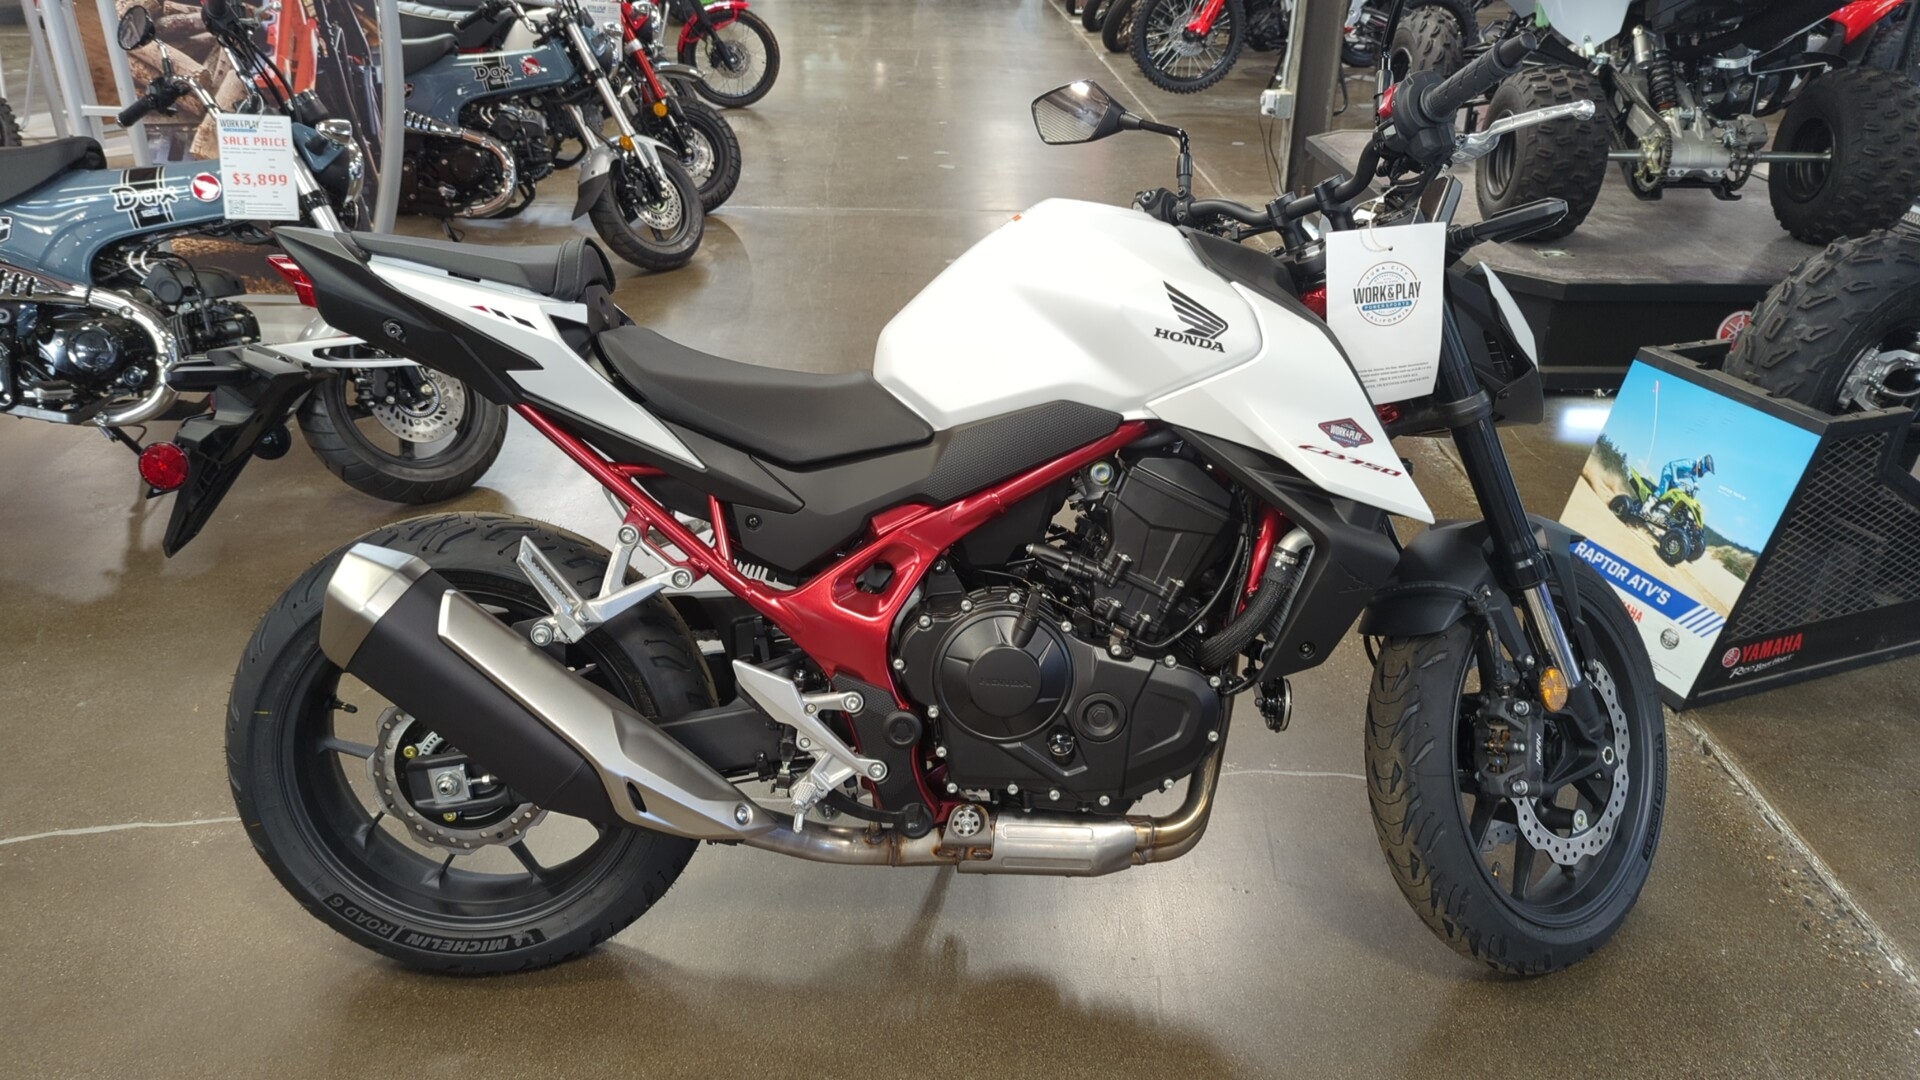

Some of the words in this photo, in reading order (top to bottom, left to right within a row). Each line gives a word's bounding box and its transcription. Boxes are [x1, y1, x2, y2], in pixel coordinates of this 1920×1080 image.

[471, 64, 514, 81] Dax
[222, 136, 249, 146] SALE
[253, 137, 288, 147] PRICE
[232, 172, 288, 187] $3,899
[109, 185, 179, 212] Dax
[1153, 327, 1226, 353] HONDA
[1574, 541, 1630, 582] RAPTOR
[1626, 574, 1671, 605] ATV'S
[1742, 632, 1804, 664] YAMAHA
[328, 895, 345, 909] 6
[343, 906, 395, 938] ROAD
[404, 932, 509, 953] MICHELIN
